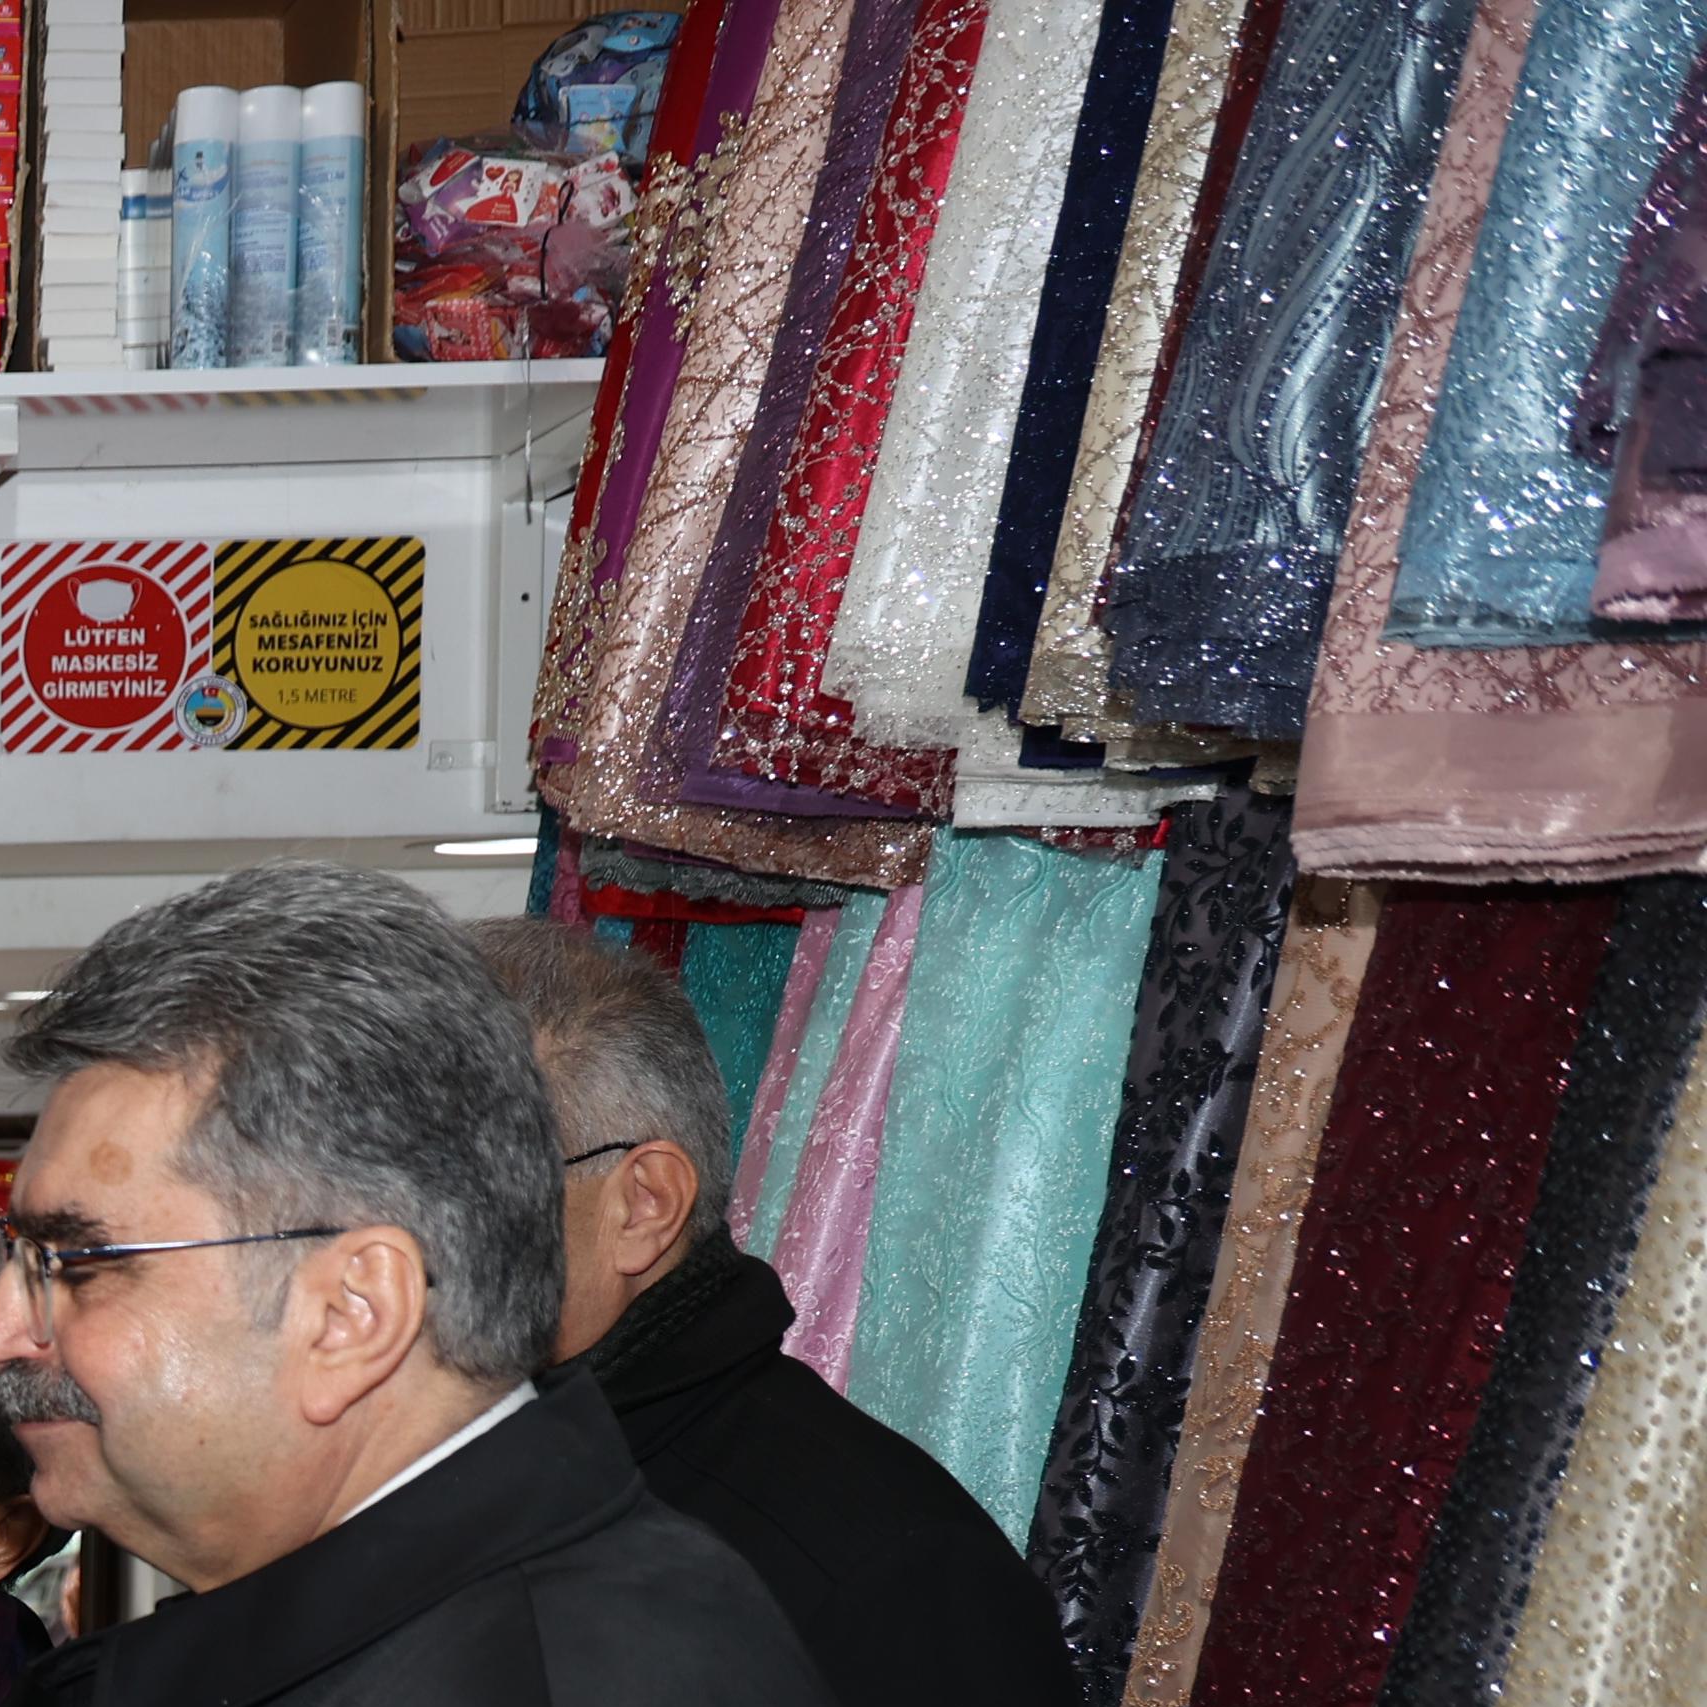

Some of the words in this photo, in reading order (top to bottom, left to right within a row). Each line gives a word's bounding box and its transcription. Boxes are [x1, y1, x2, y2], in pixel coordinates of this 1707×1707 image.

[249, 610, 347, 629] SAĞLIĞINIZ
[352, 609, 387, 630] İÇİN
[64, 625, 146, 647] LÜTFEN
[257, 629, 379, 650] MESAFENİZİ
[51, 650, 159, 673] MASKESİZ
[252, 656, 384, 674] KORUYUNUZ
[42, 675, 167, 700] GİRMEYİNİZ
[278, 689, 300, 705] 1,5
[304, 688, 357, 703] METRE
